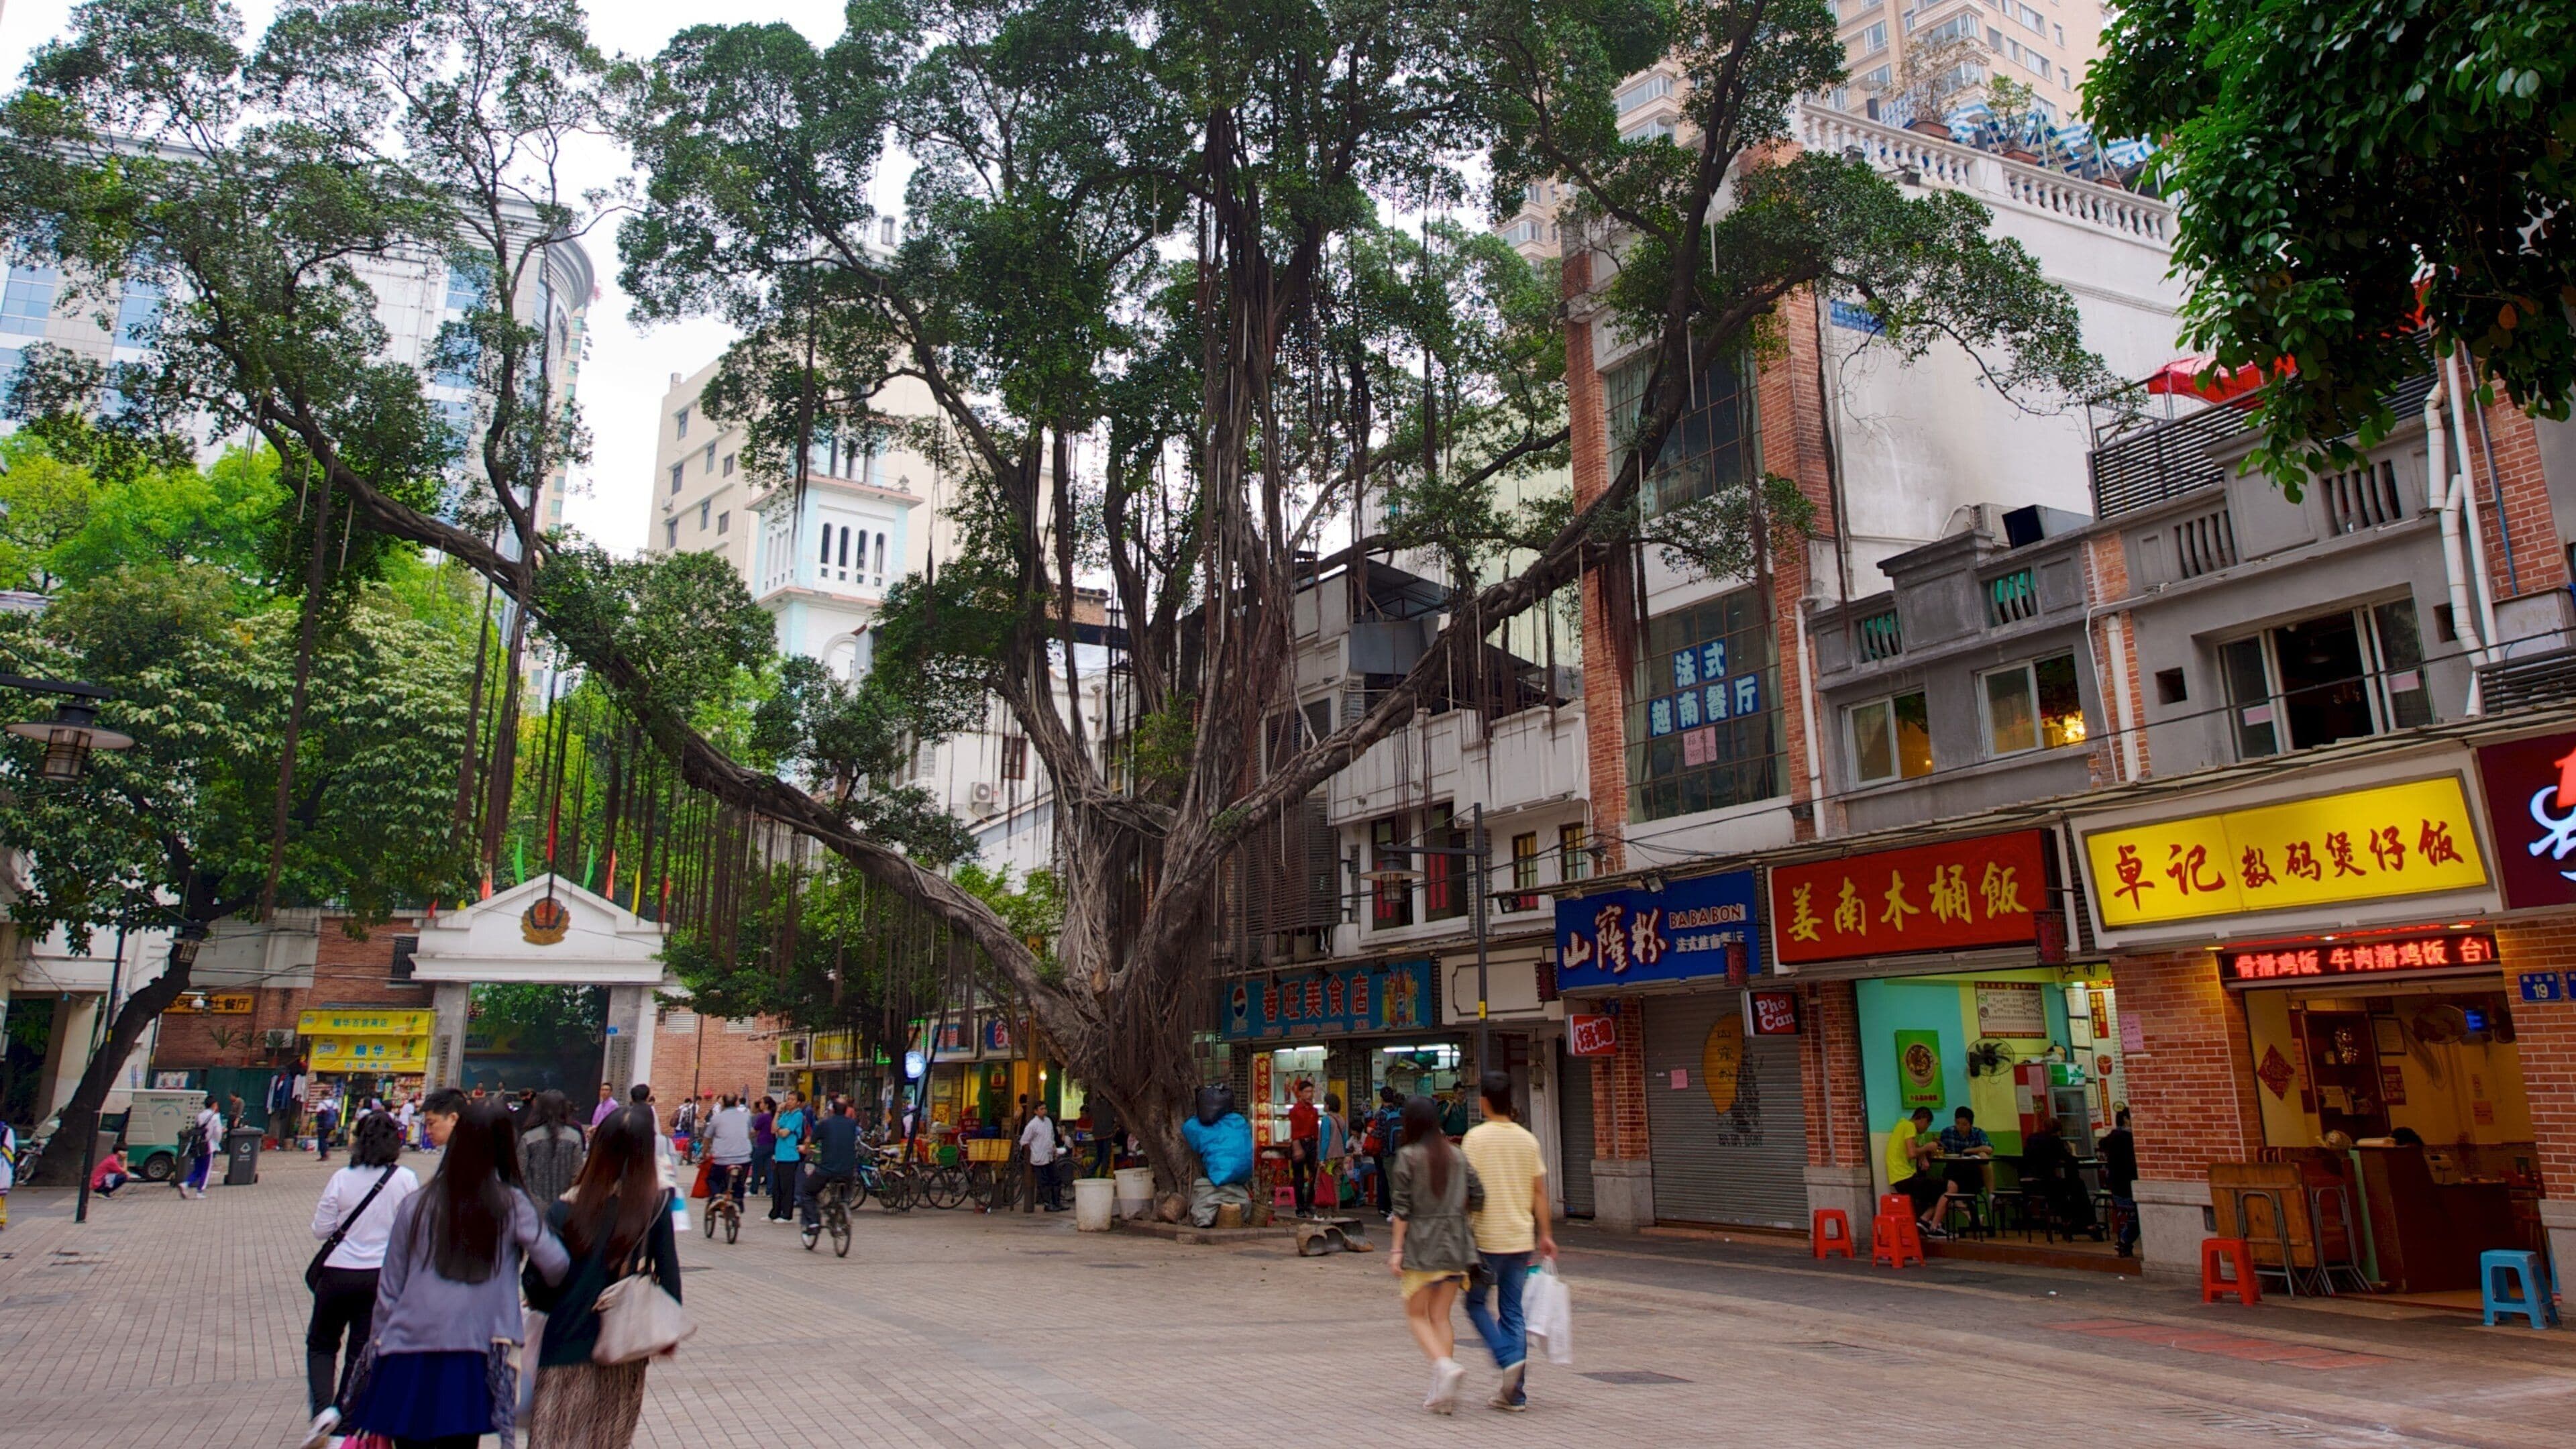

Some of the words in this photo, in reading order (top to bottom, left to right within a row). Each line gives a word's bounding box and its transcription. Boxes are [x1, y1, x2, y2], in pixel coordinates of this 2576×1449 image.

[1675, 642, 1725, 688] 法式
[1652, 676, 1756, 736] 越南餐厅
[2114, 819, 2464, 912] 卓记数码煲仔饭
[1669, 904, 1746, 929] BABABON
[2532, 983, 2548, 999] 19
